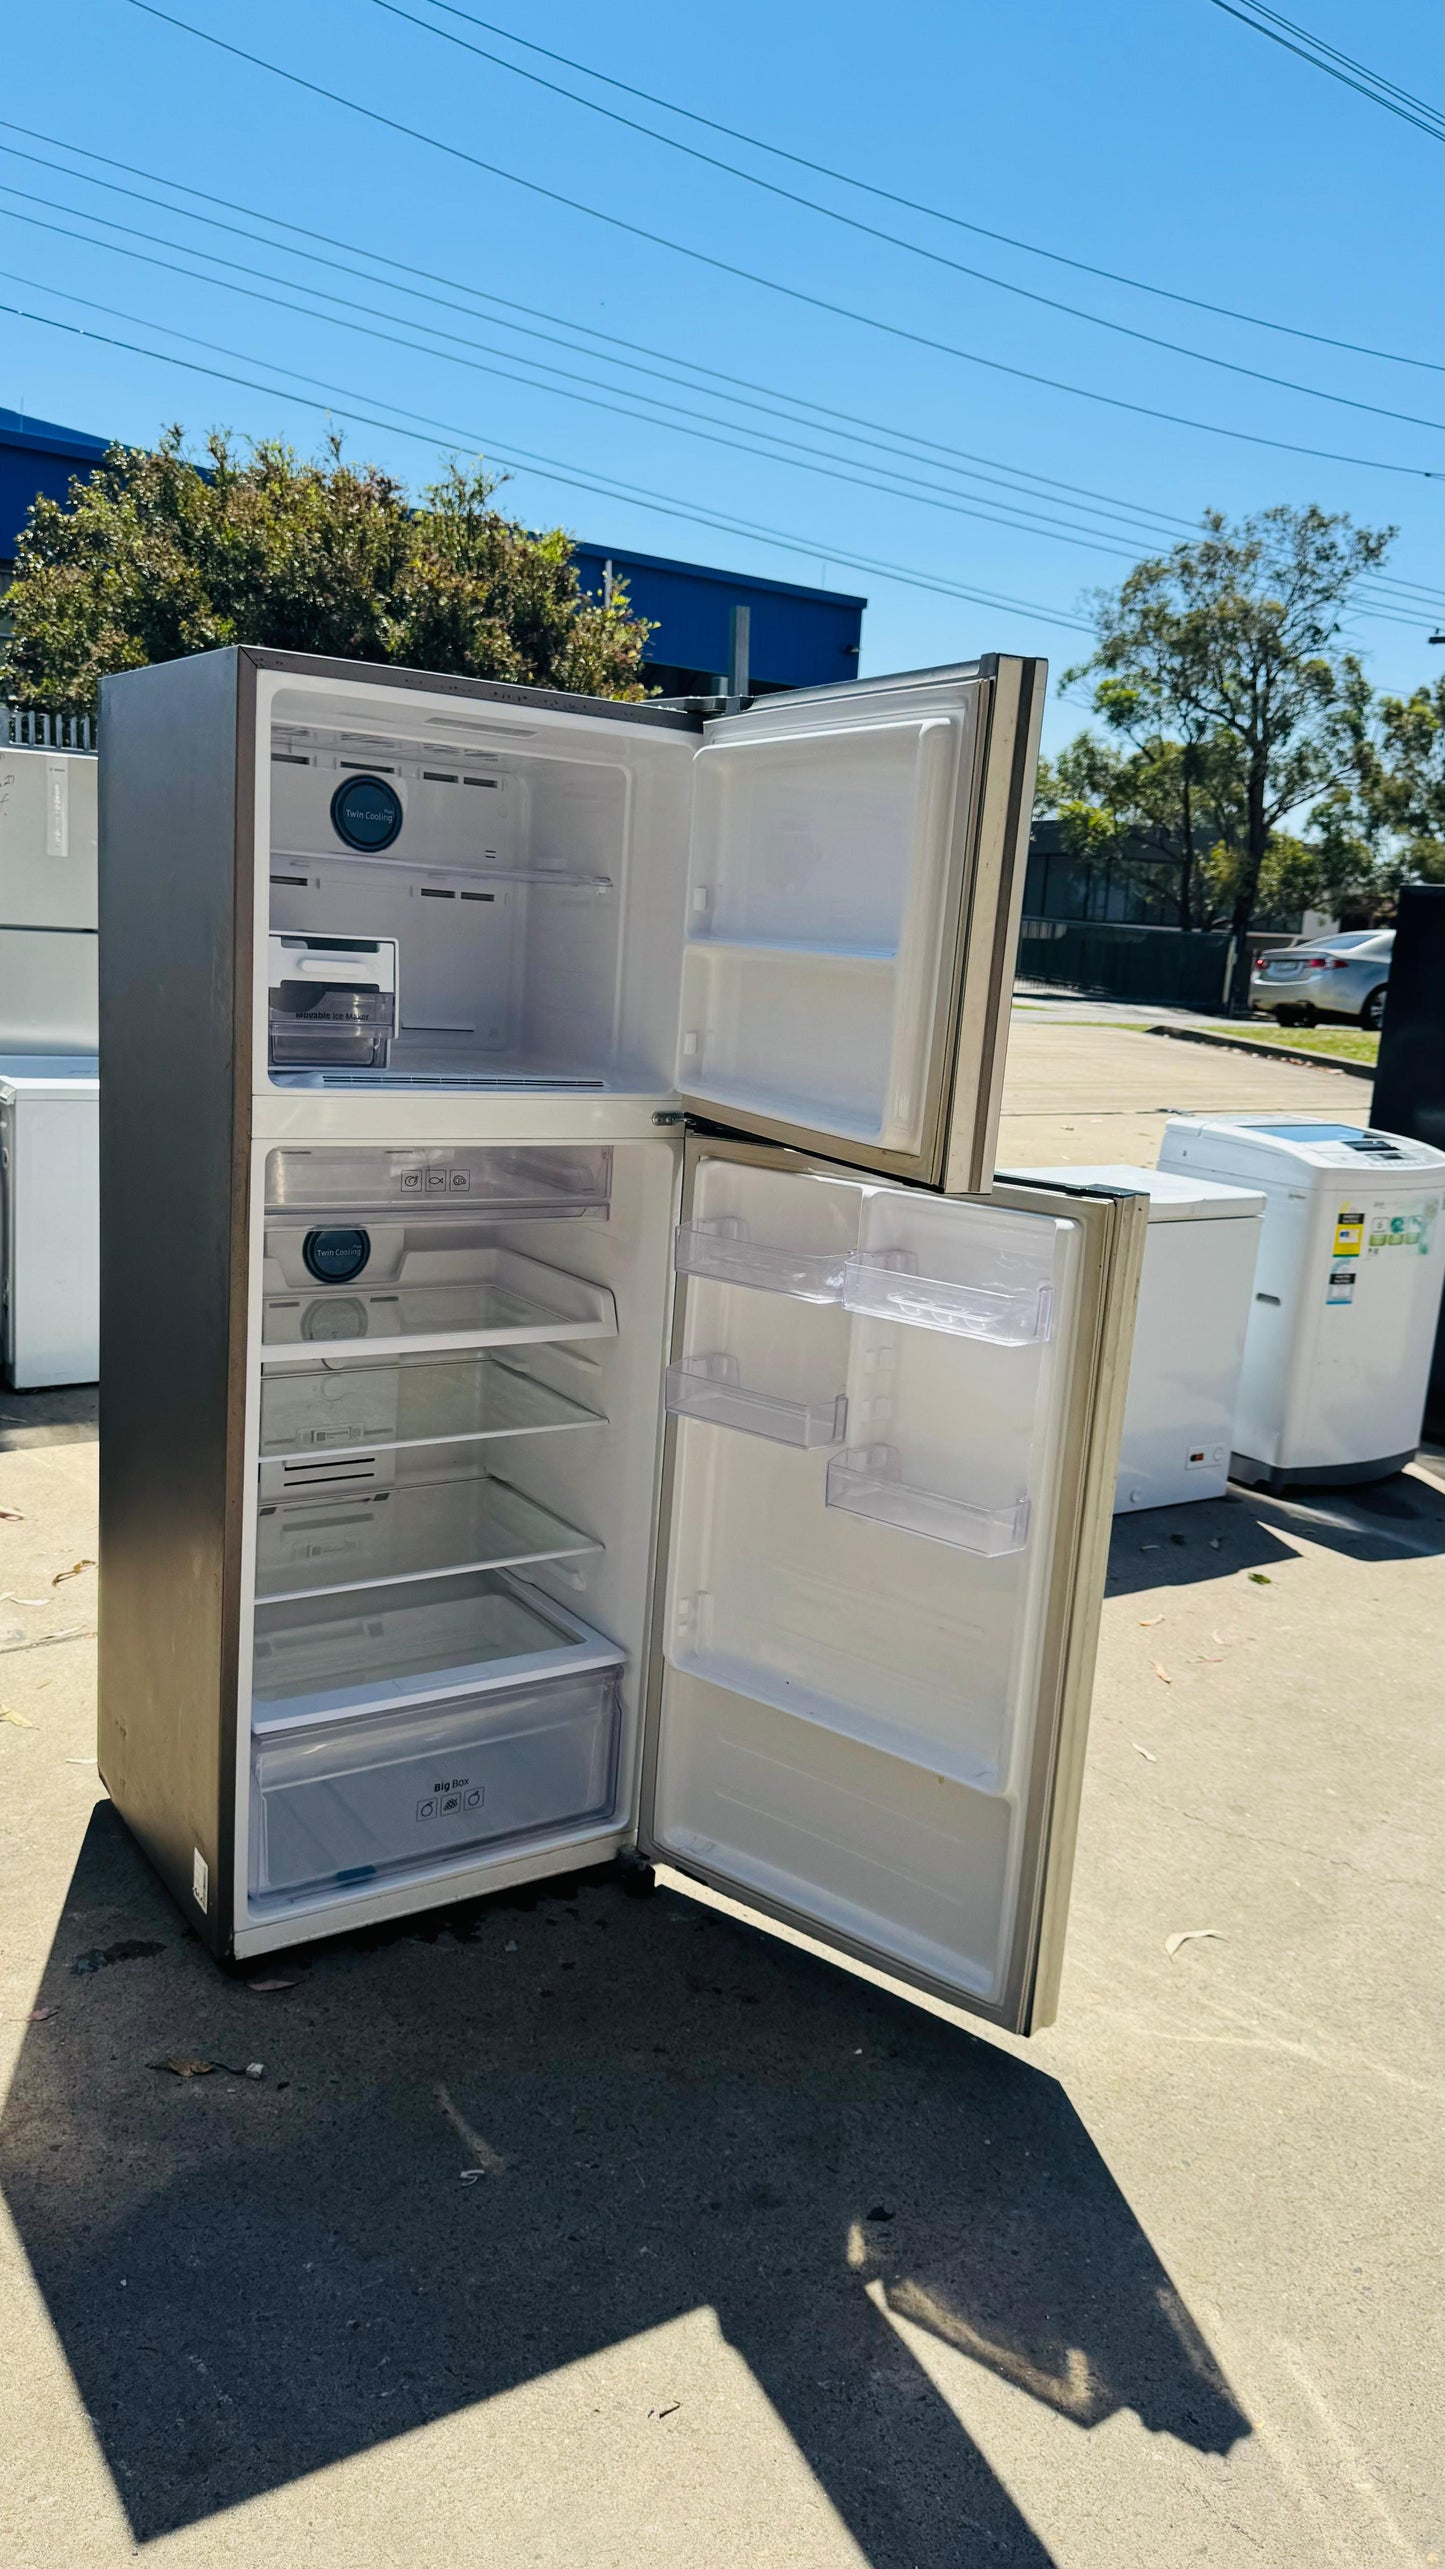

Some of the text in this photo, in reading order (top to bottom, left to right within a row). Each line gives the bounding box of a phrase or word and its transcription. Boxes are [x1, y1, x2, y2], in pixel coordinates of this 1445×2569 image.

[346, 809, 364, 819] Twin
[365, 811, 393, 824] Cooling
[295, 1011, 331, 1020] Movable
[345, 1013, 369, 1021] Maker
[317, 1249, 335, 1257] Twin
[335, 1248, 361, 1256] Cooling
[434, 1778, 470, 1792] Big Box
